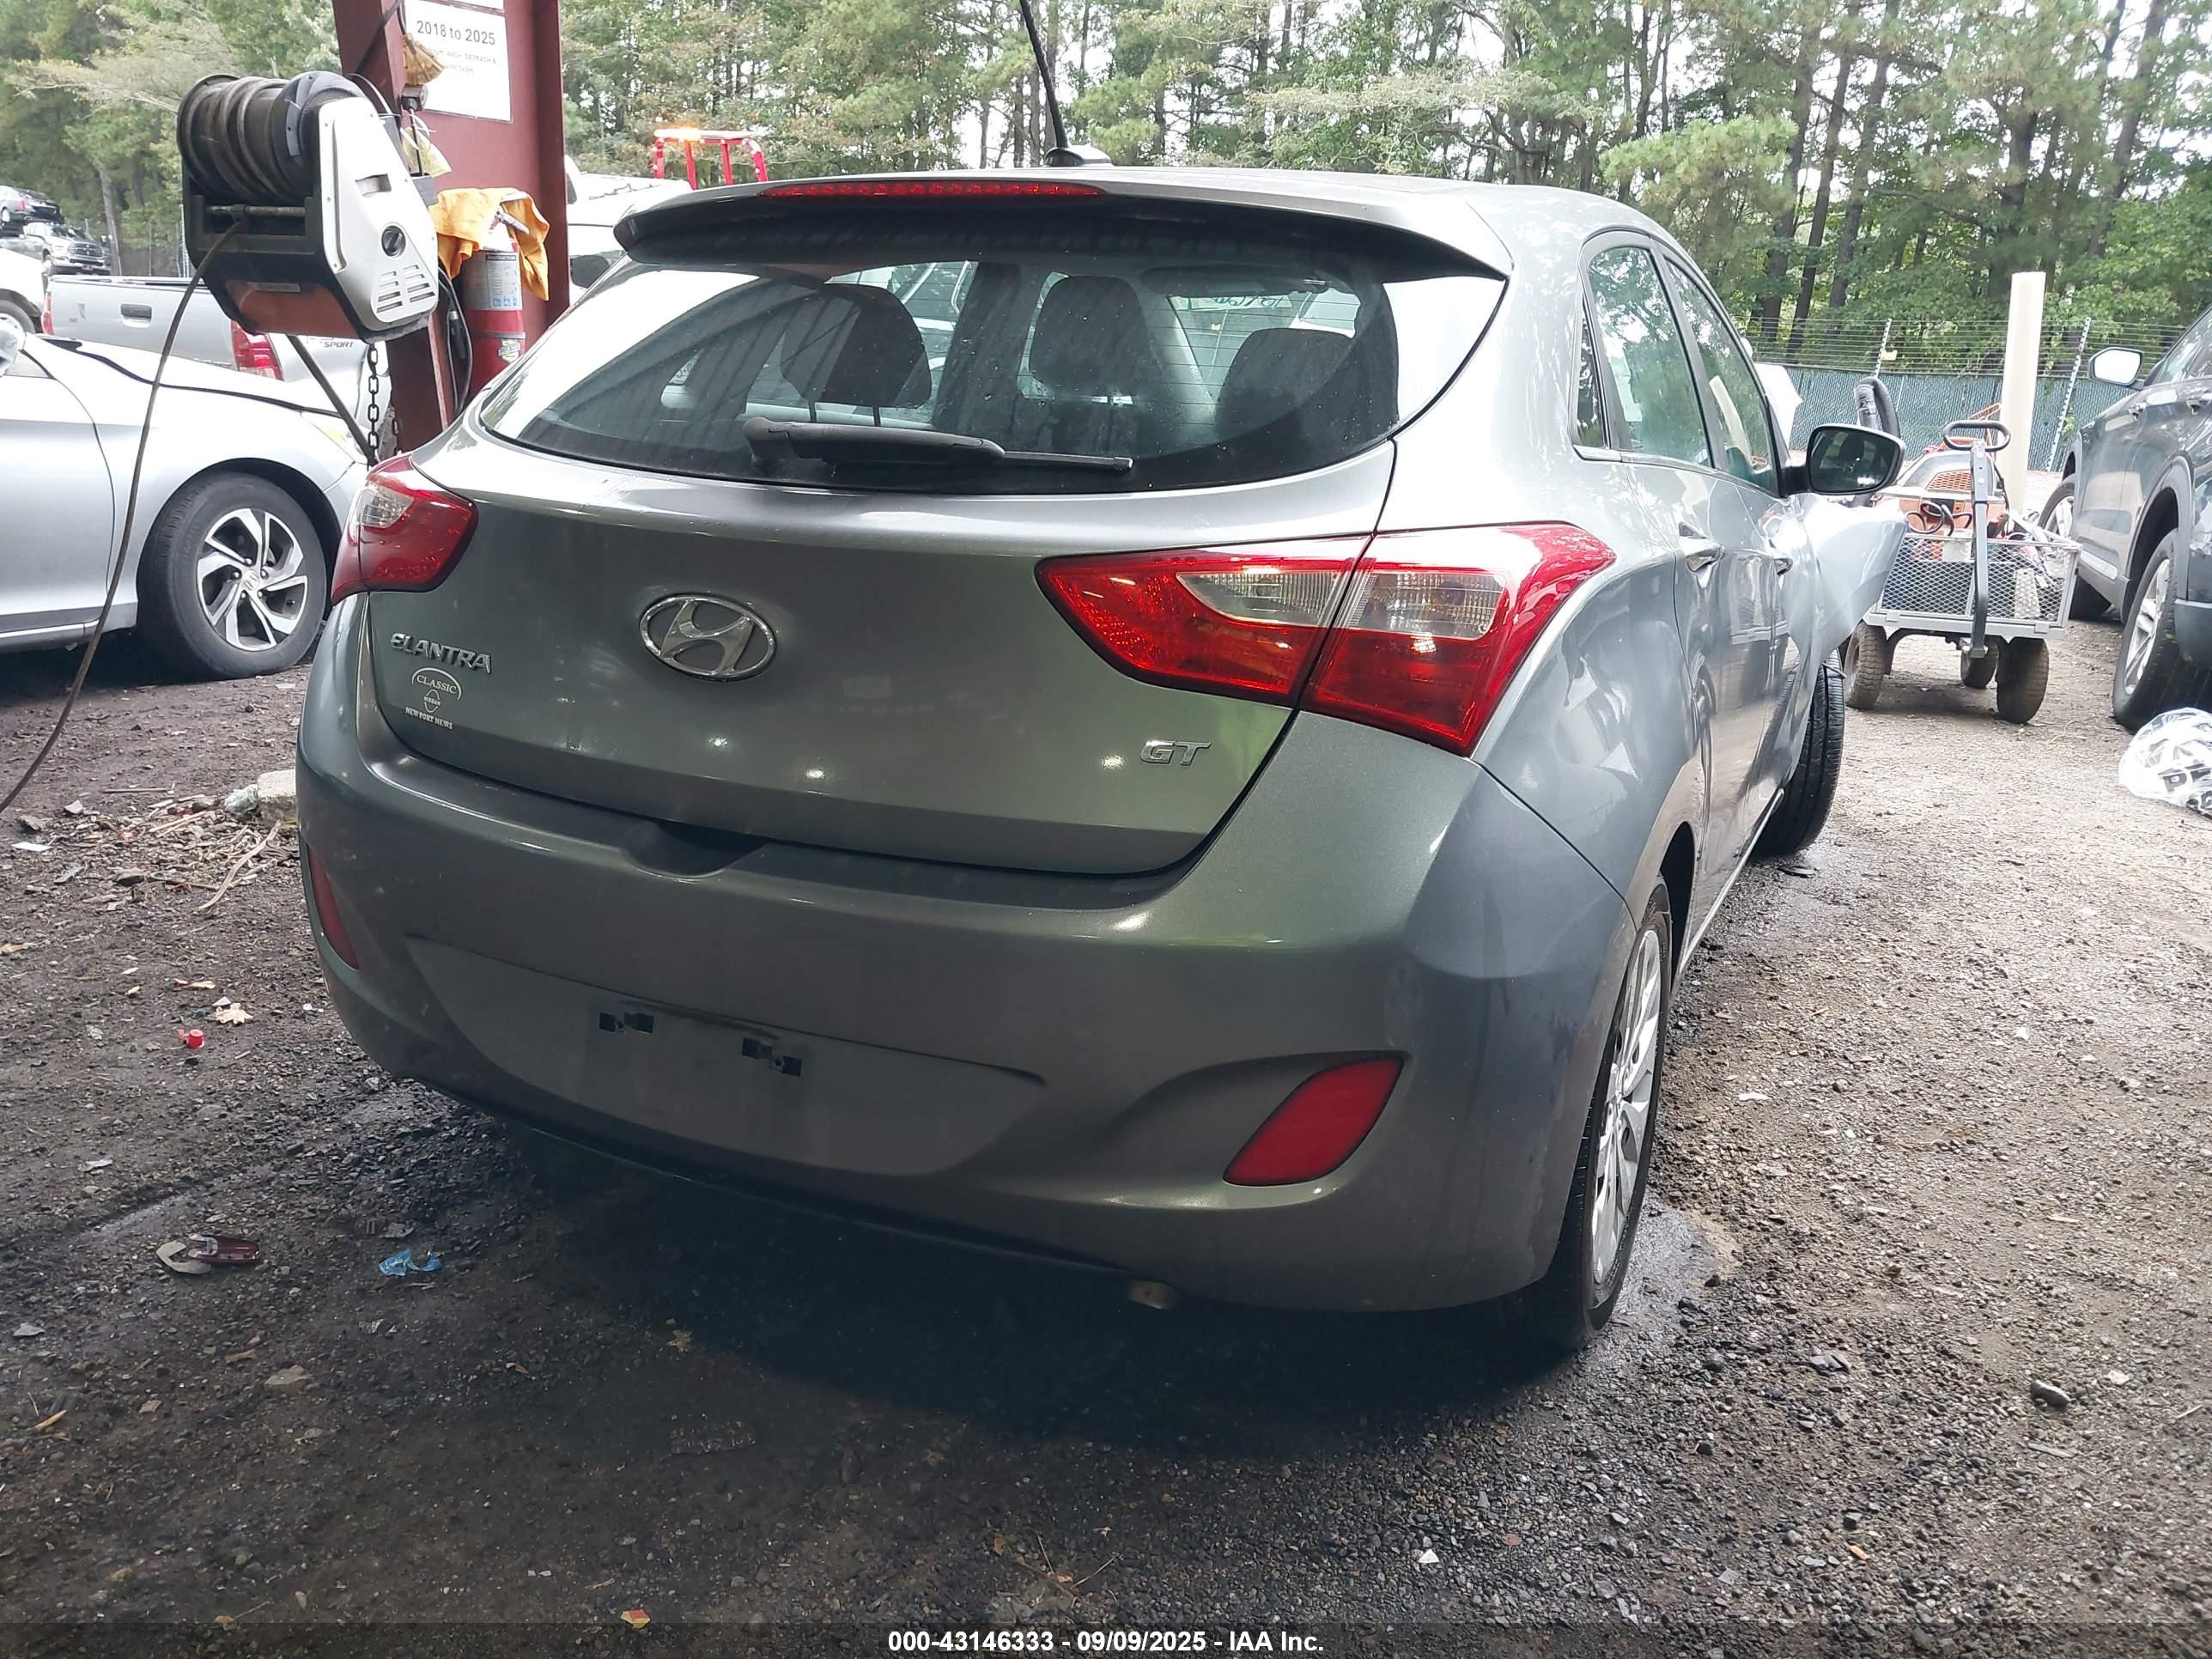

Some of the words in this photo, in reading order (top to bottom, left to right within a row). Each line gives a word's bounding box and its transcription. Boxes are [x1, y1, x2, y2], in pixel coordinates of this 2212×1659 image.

[416, 21, 447, 38] 2018
[449, 27, 462, 40] to
[465, 28, 495, 46] 2025
[391, 632, 492, 674] ELANTRA
[416, 674, 459, 695] CLASSIC
[405, 706, 434, 724] NEWPORT
[434, 716, 454, 730] NEWS
[1140, 739, 1212, 767] GT
